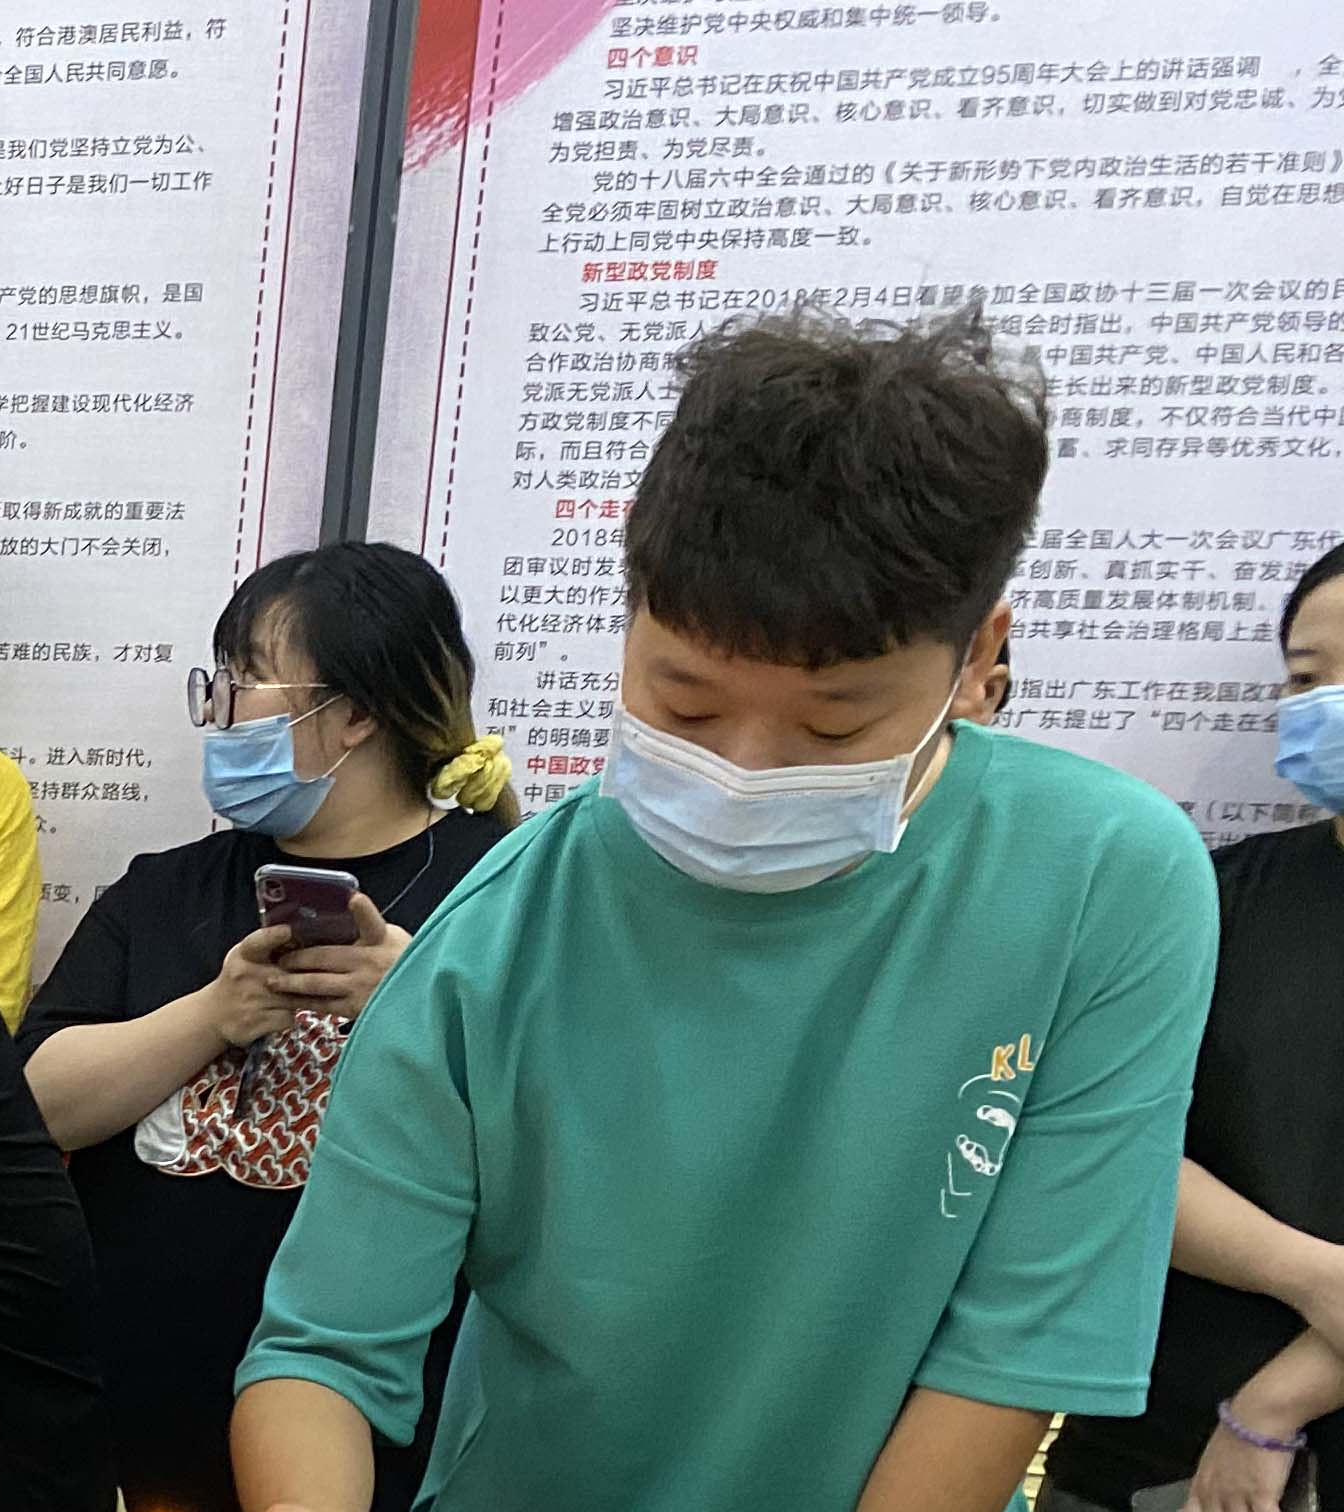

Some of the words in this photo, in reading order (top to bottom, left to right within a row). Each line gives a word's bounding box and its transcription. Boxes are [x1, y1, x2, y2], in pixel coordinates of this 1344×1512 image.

[606, 45, 700, 70] 四个意识
[581, 258, 719, 284] 新型政党制度
[990, 1033, 1043, 1081] KL
